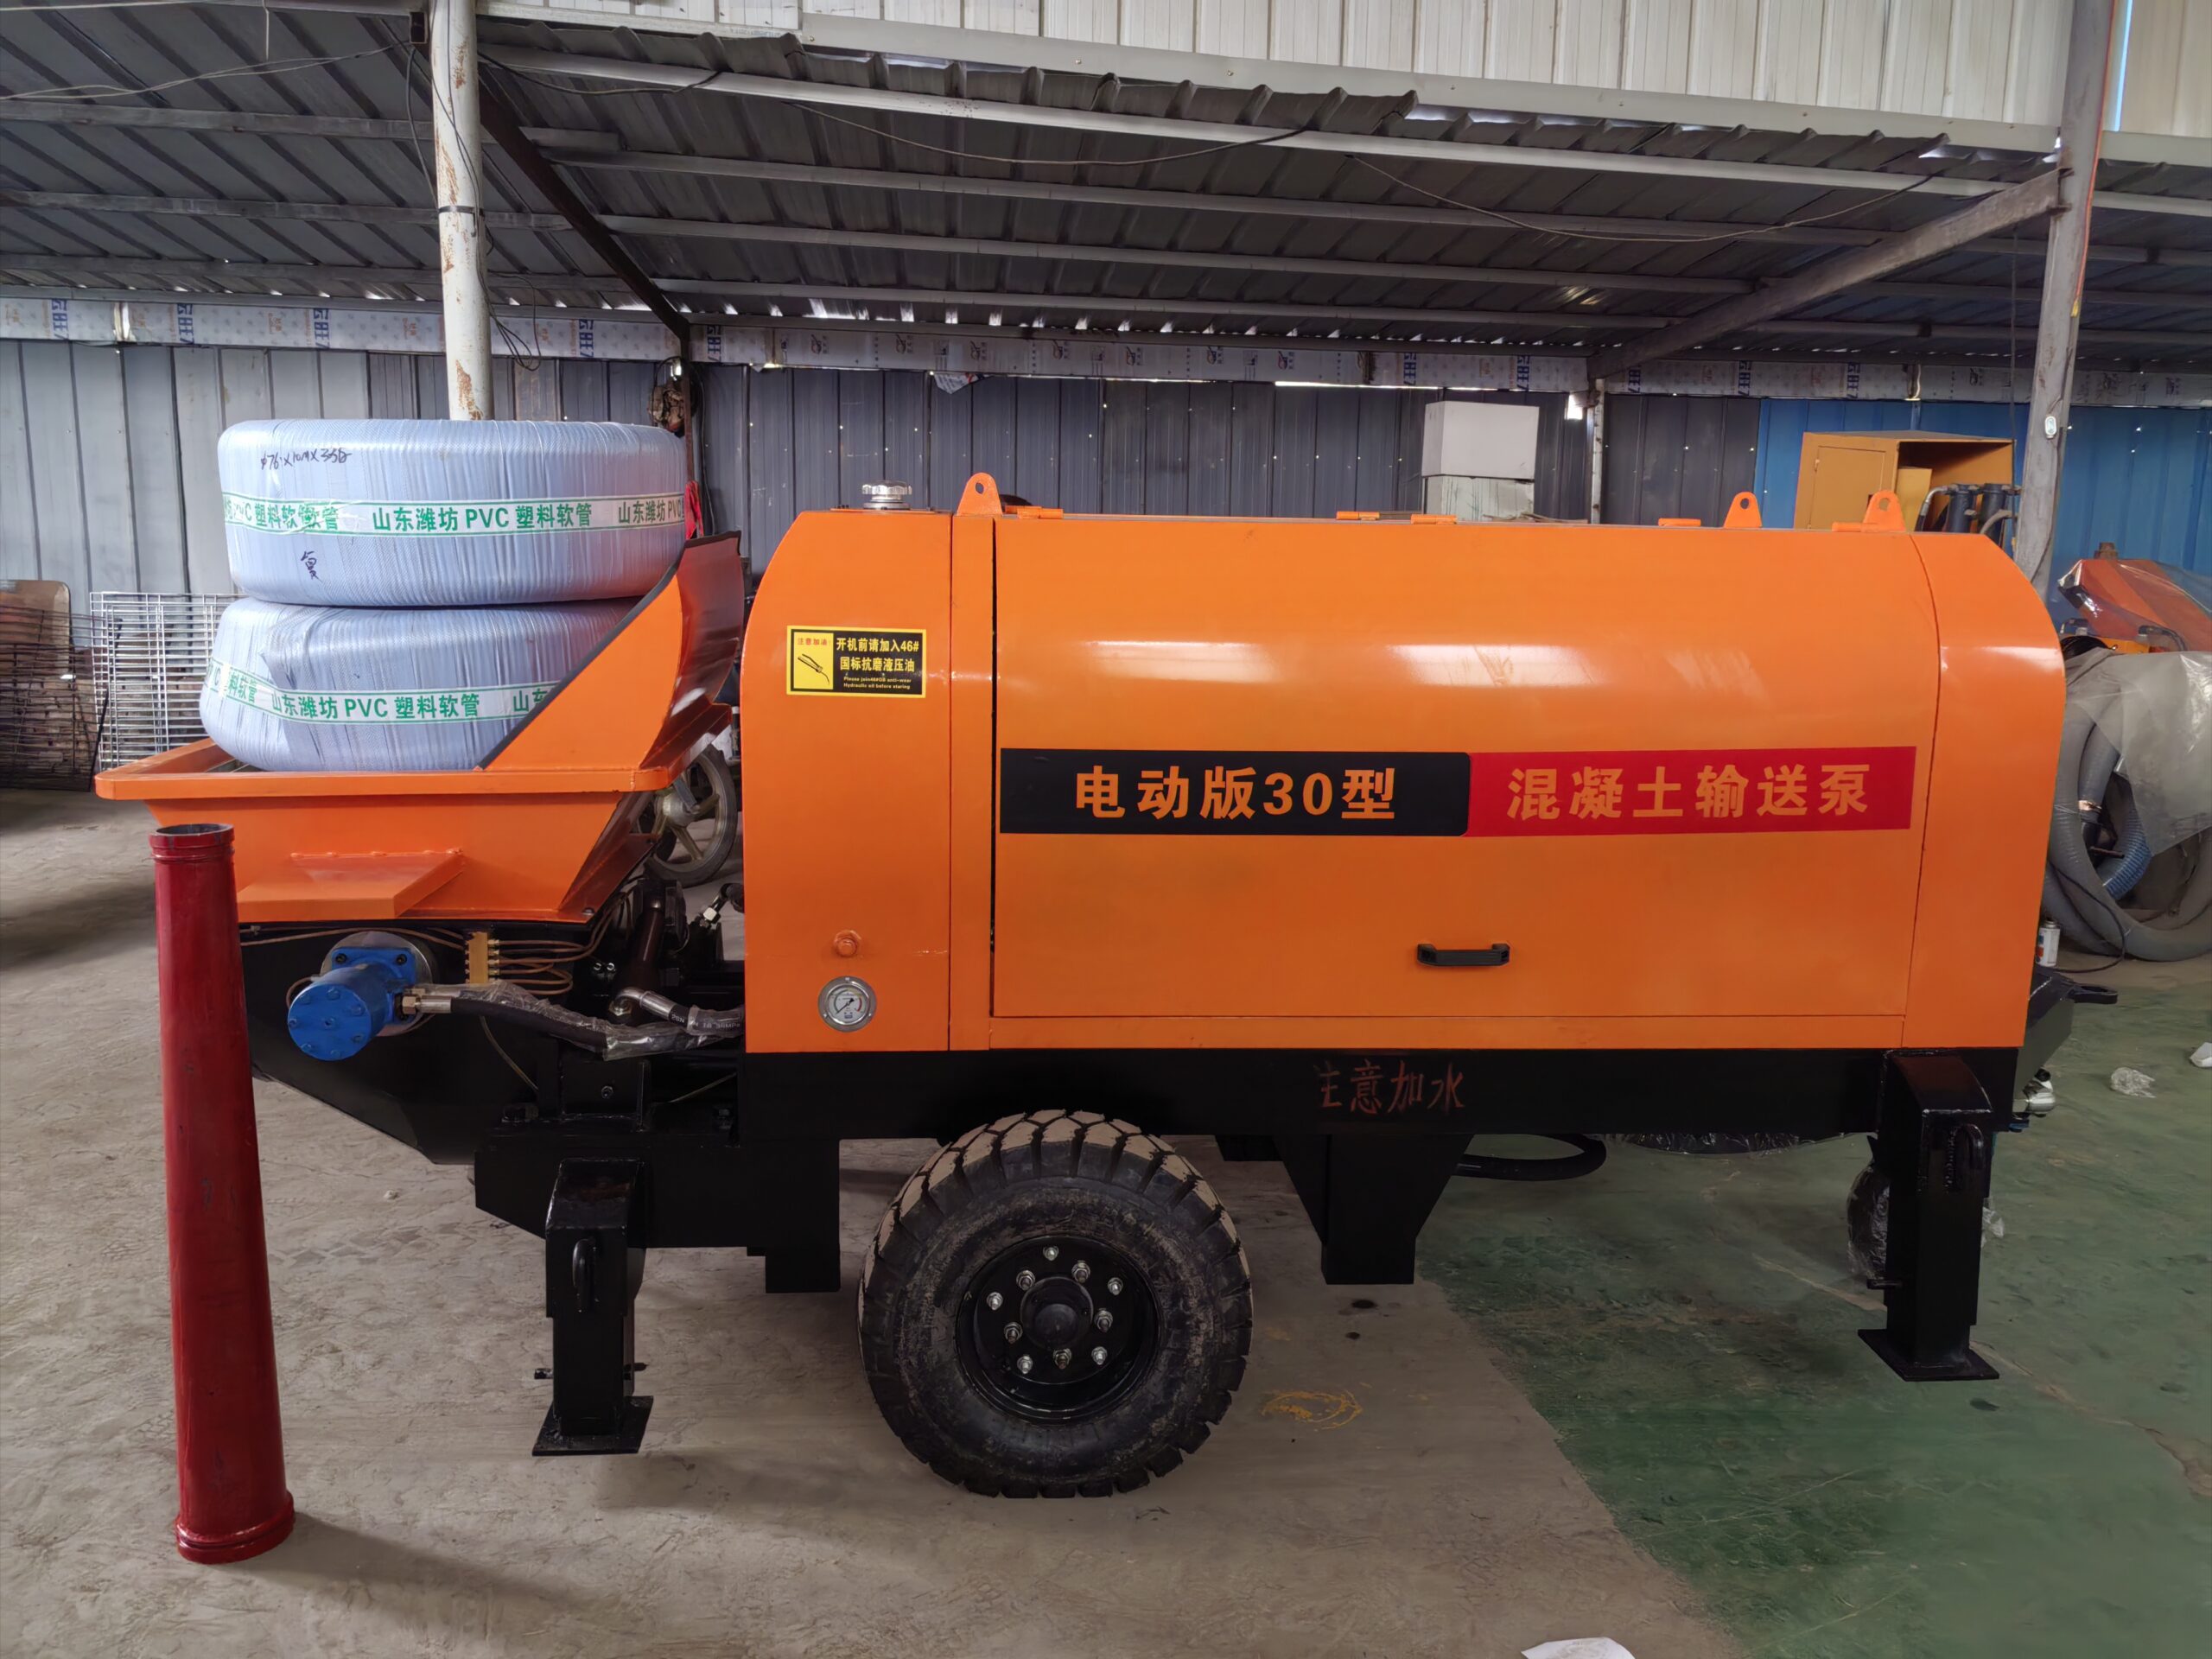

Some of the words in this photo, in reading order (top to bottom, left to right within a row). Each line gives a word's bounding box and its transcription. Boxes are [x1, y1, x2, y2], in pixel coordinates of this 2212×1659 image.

[372, 507, 458, 531] 山东潍坊
[465, 507, 510, 529] PVC
[516, 502, 593, 529] 塑料软管
[619, 499, 665, 524] 山东潍坊
[836, 638, 919, 652] 开机前请加入46#
[840, 656, 915, 672] 国标抗磨液压油
[271, 690, 339, 719] 山东潍坊
[344, 698, 389, 718] PVC
[395, 693, 480, 719] 塑料软管
[1076, 765, 1395, 820] 电动版30型
[1506, 763, 1871, 821] 混凝土输送泵
